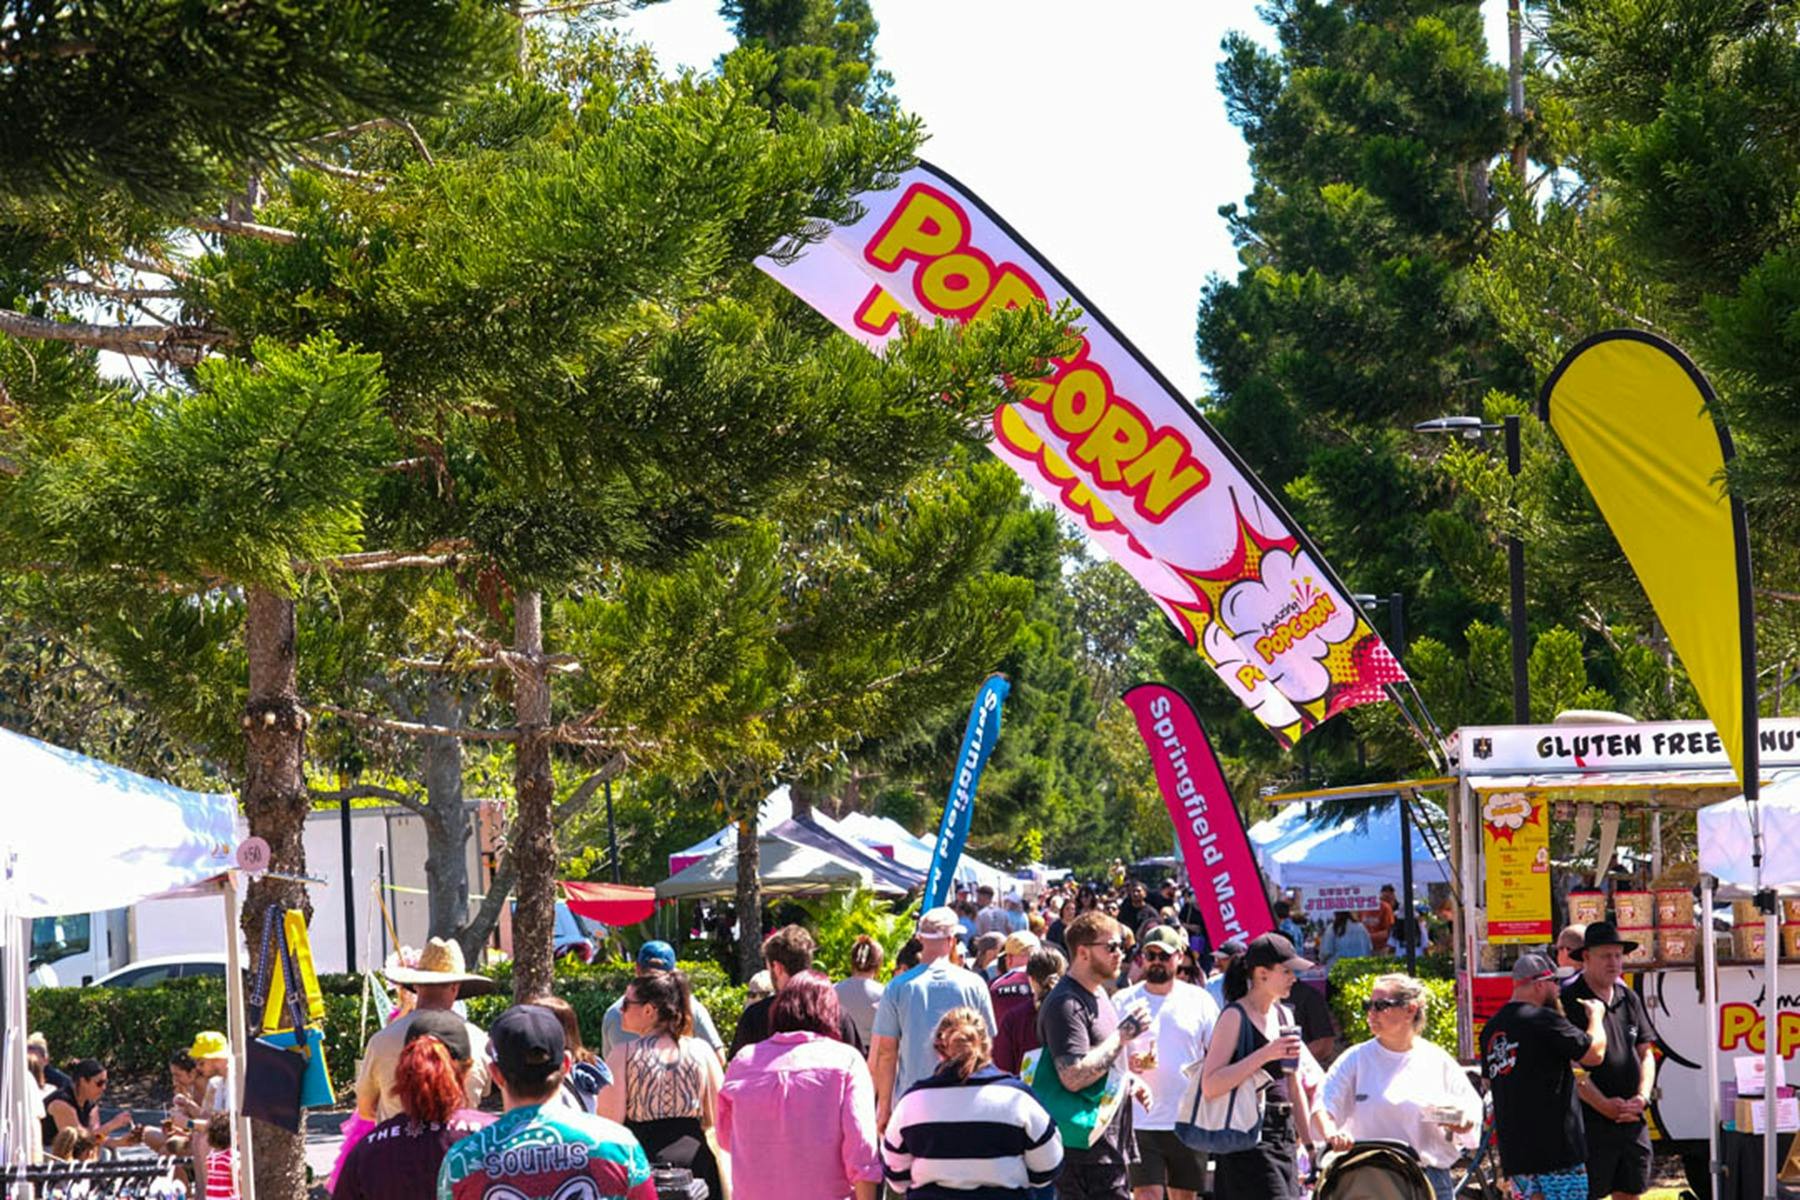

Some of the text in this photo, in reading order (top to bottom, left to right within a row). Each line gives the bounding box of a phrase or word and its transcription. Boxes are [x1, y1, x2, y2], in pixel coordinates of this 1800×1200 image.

[1254, 592, 1336, 665] POPCORN
[1537, 729, 1800, 759] GLUTEN FREE NU
[1150, 695, 1224, 867] Springfield
[367, 1126, 401, 1144] THE
[483, 1142, 589, 1179] SOUTHS
